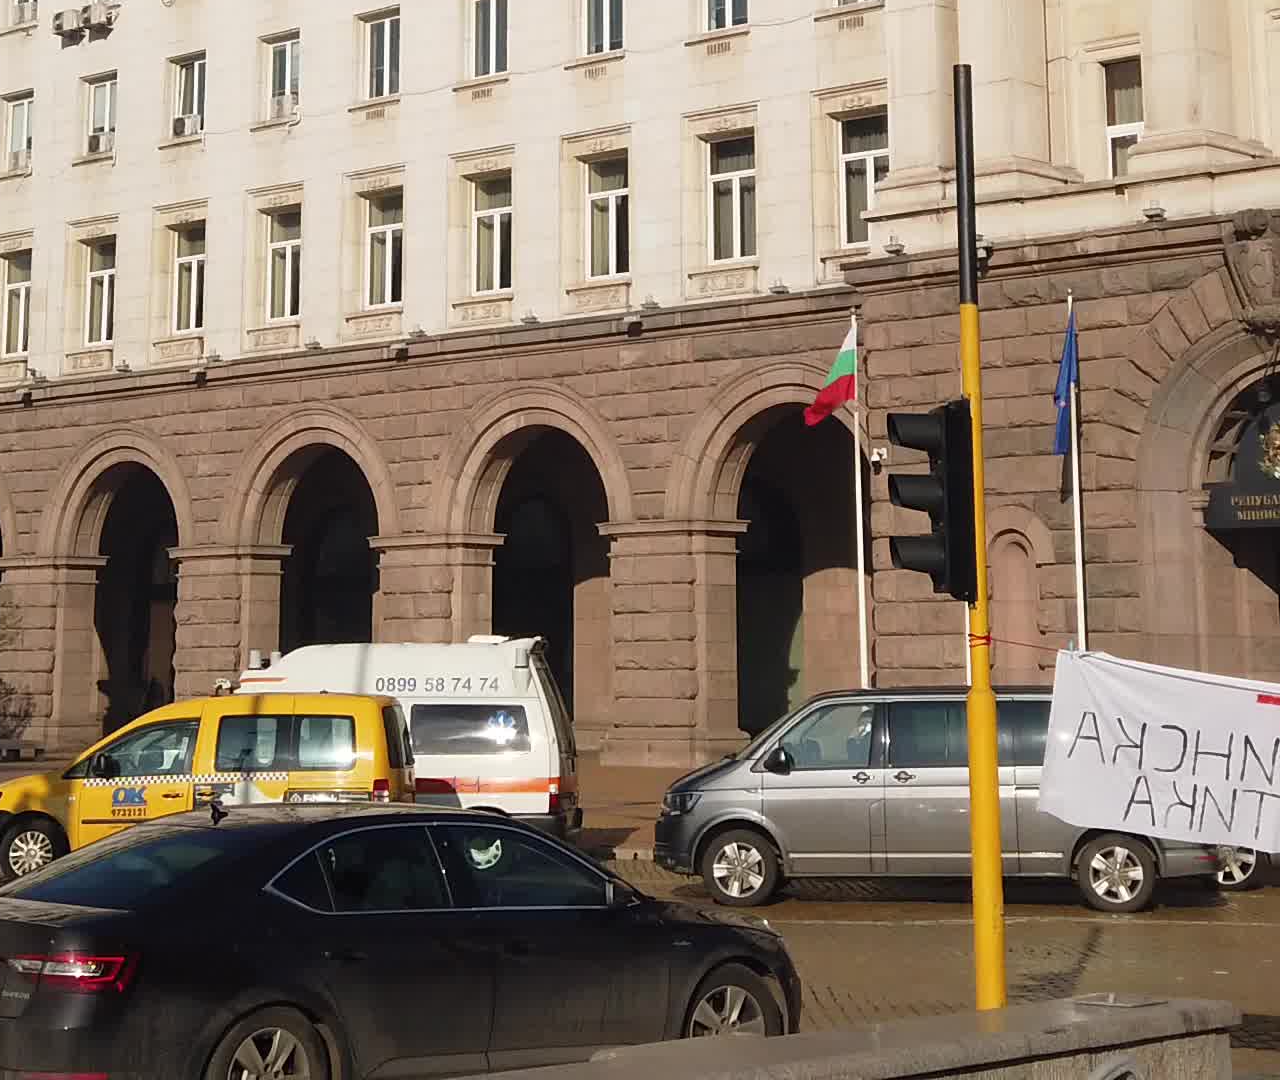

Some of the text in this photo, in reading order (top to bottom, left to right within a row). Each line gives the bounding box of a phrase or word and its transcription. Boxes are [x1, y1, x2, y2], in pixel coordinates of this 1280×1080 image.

[375, 677, 500, 692] 0899 58 74 74
[111, 807, 147, 817] 9732121
